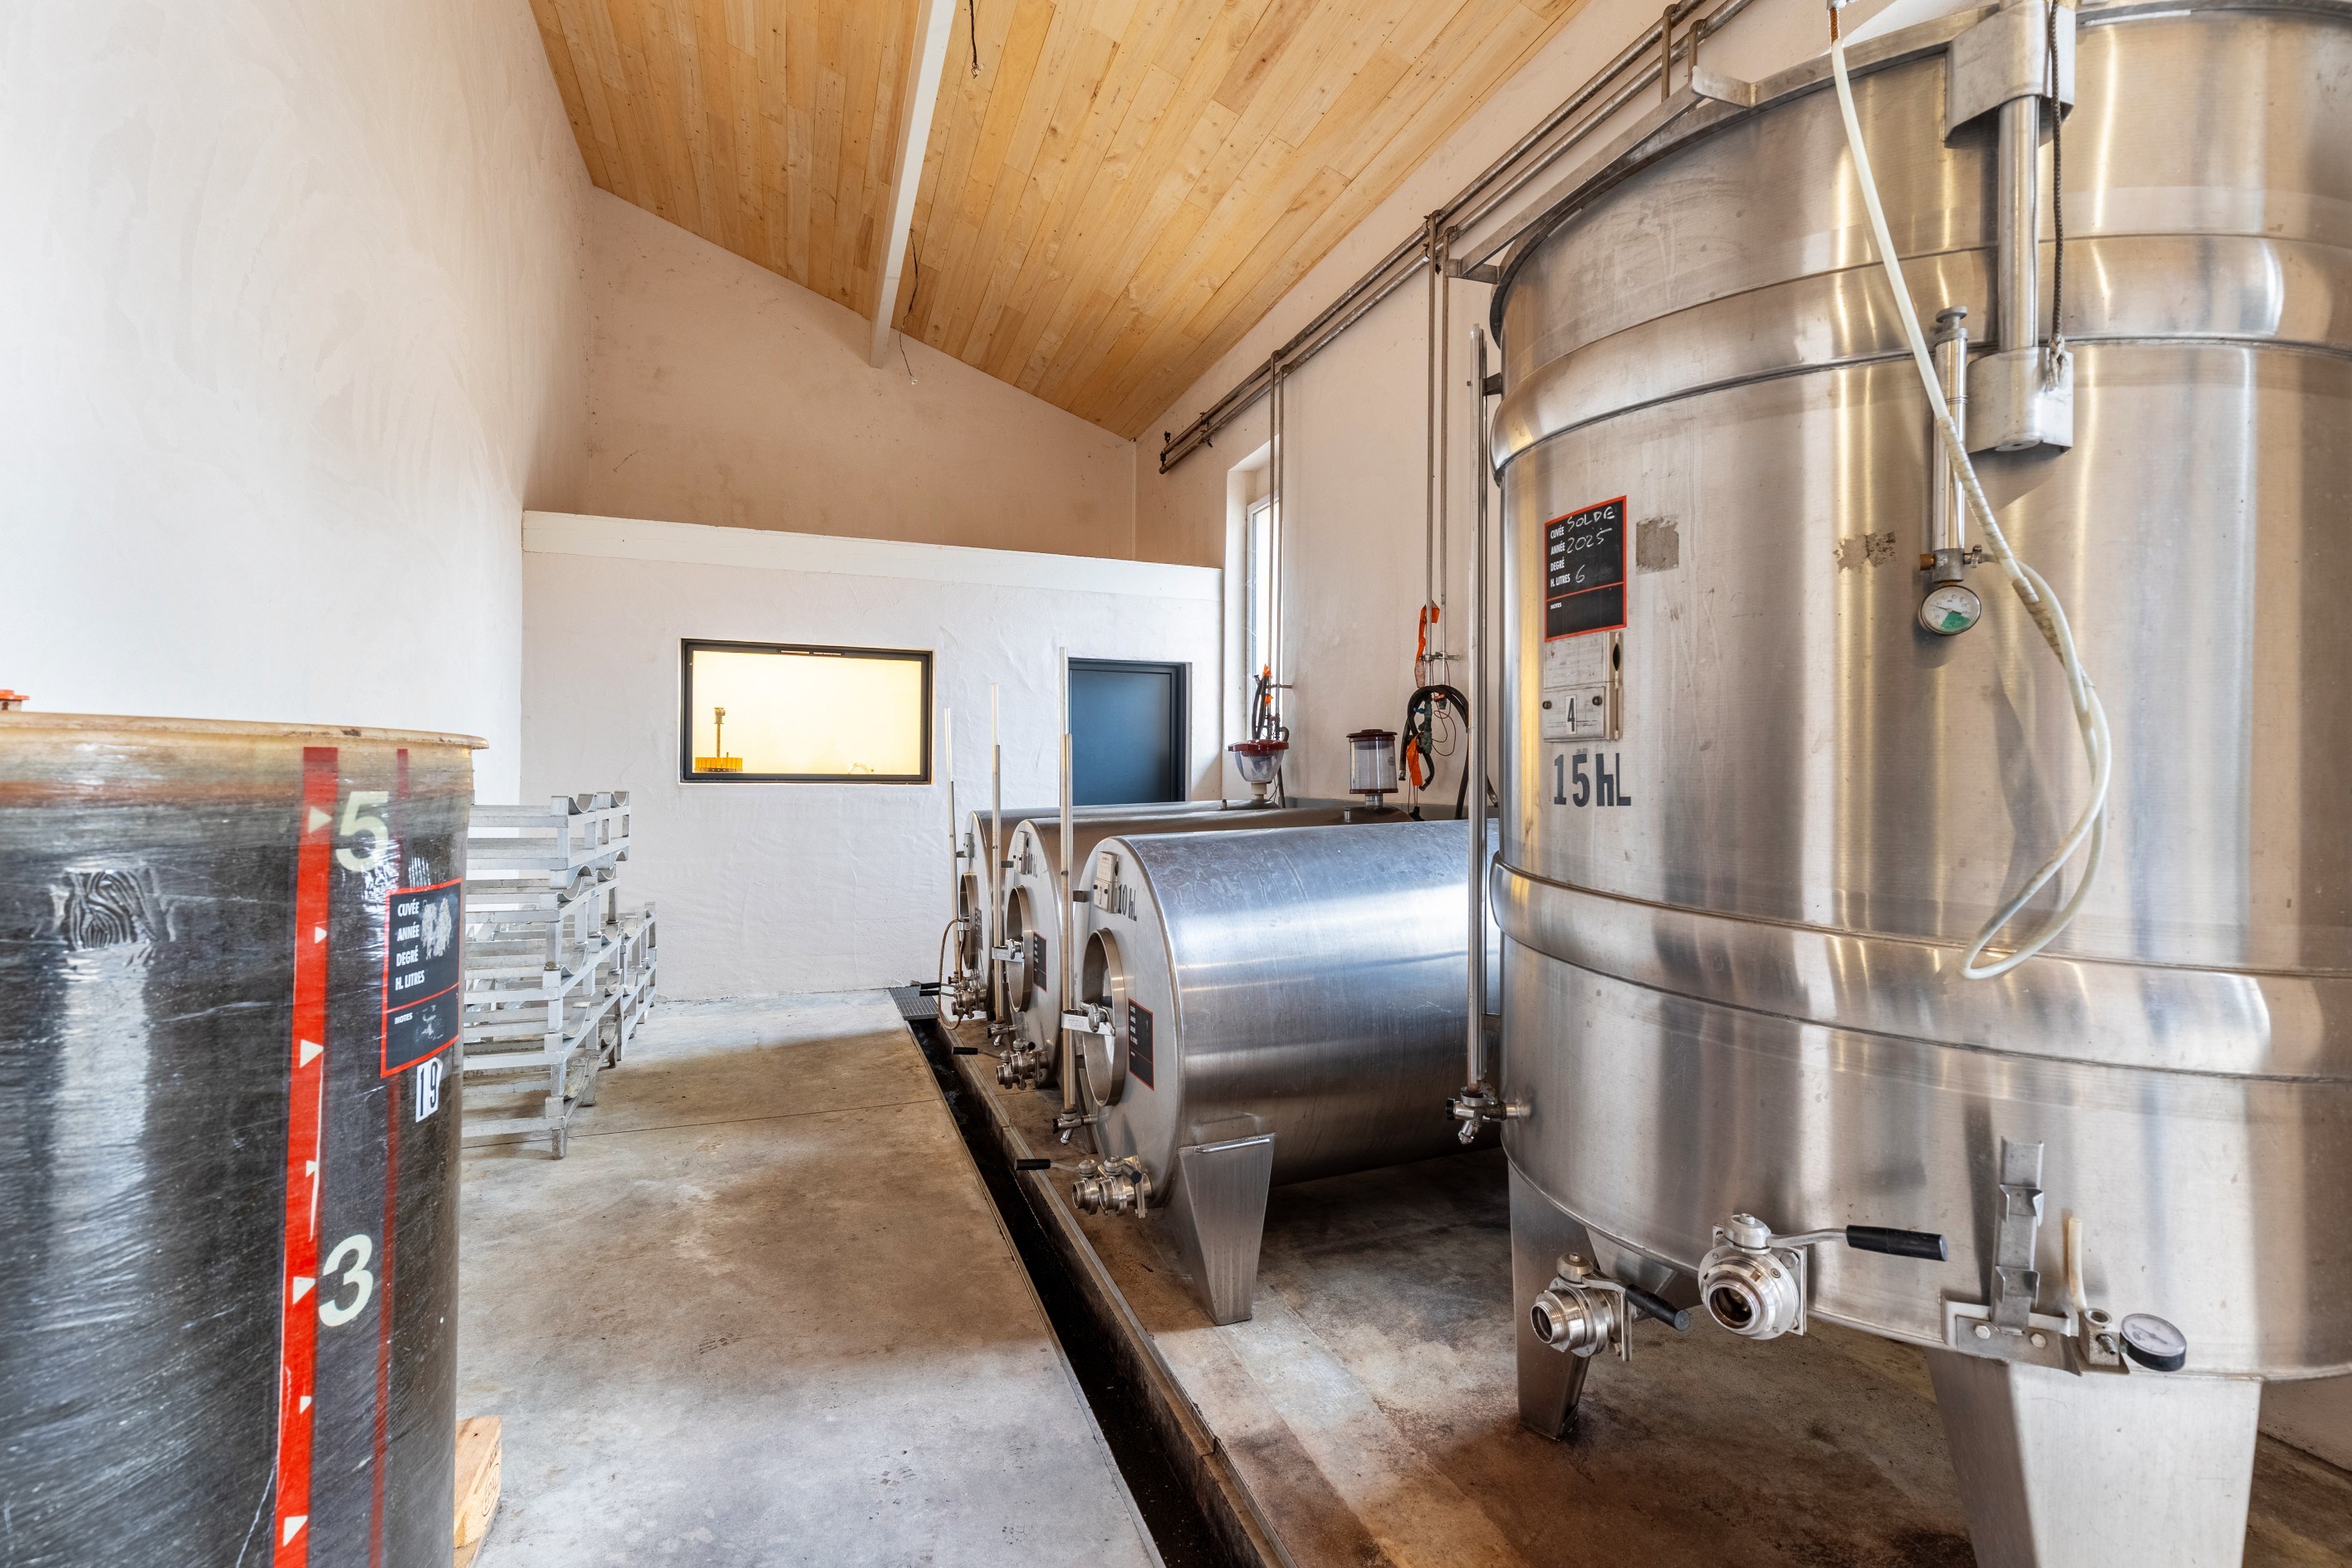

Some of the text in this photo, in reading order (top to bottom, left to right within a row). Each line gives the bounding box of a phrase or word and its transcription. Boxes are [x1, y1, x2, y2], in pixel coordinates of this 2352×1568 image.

[1567, 506, 1615, 532] SOLDE
[1550, 525, 1565, 539] CUVÉE
[1566, 527, 1613, 554] 2025
[1551, 541, 1566, 556] ANNÉE
[1550, 556, 1565, 572] DEGRÉ
[1556, 573, 1570, 586] LITRES
[1575, 565, 1585, 583] 6
[1550, 601, 1562, 610] NOTES
[1567, 698, 1575, 732] 4
[335, 791, 389, 872] 5
[397, 899, 420, 917] CUVÉE
[397, 922, 420, 942] ANNÉE
[396, 945, 419, 967] DEGRÉ
[404, 970, 425, 988] LITRES
[394, 1012, 414, 1025] NOTES
[420, 1061, 438, 1117] 19
[318, 1234, 374, 1327] 3
